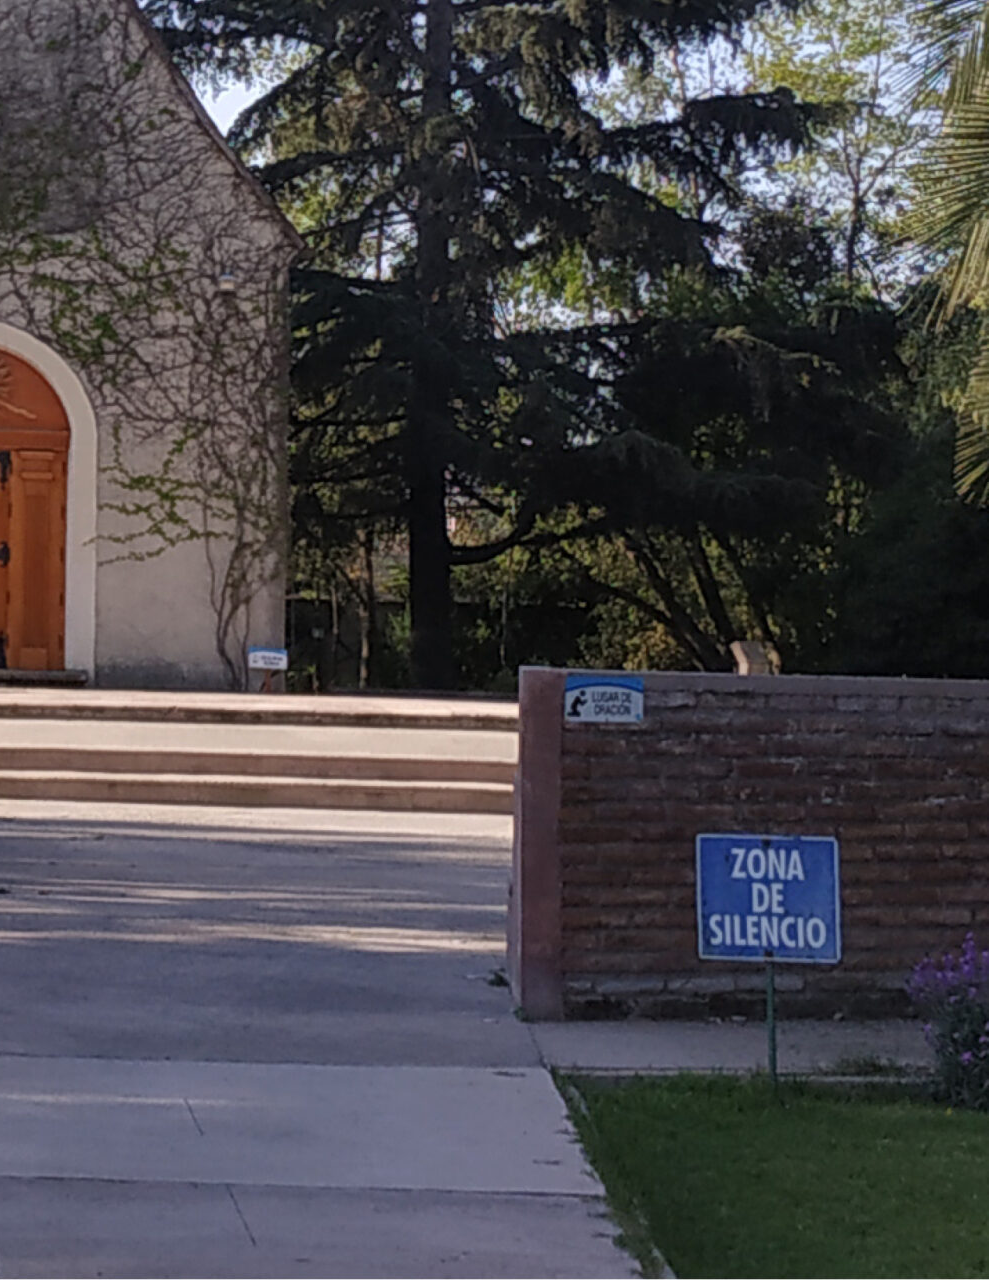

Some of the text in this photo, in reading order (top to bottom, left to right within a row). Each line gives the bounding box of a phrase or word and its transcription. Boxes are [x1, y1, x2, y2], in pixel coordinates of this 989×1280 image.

[591, 691, 632, 703] LUGAR DE
[731, 848, 805, 881] ZONA
[751, 882, 785, 914] DE
[709, 914, 826, 949] SILENCIO
